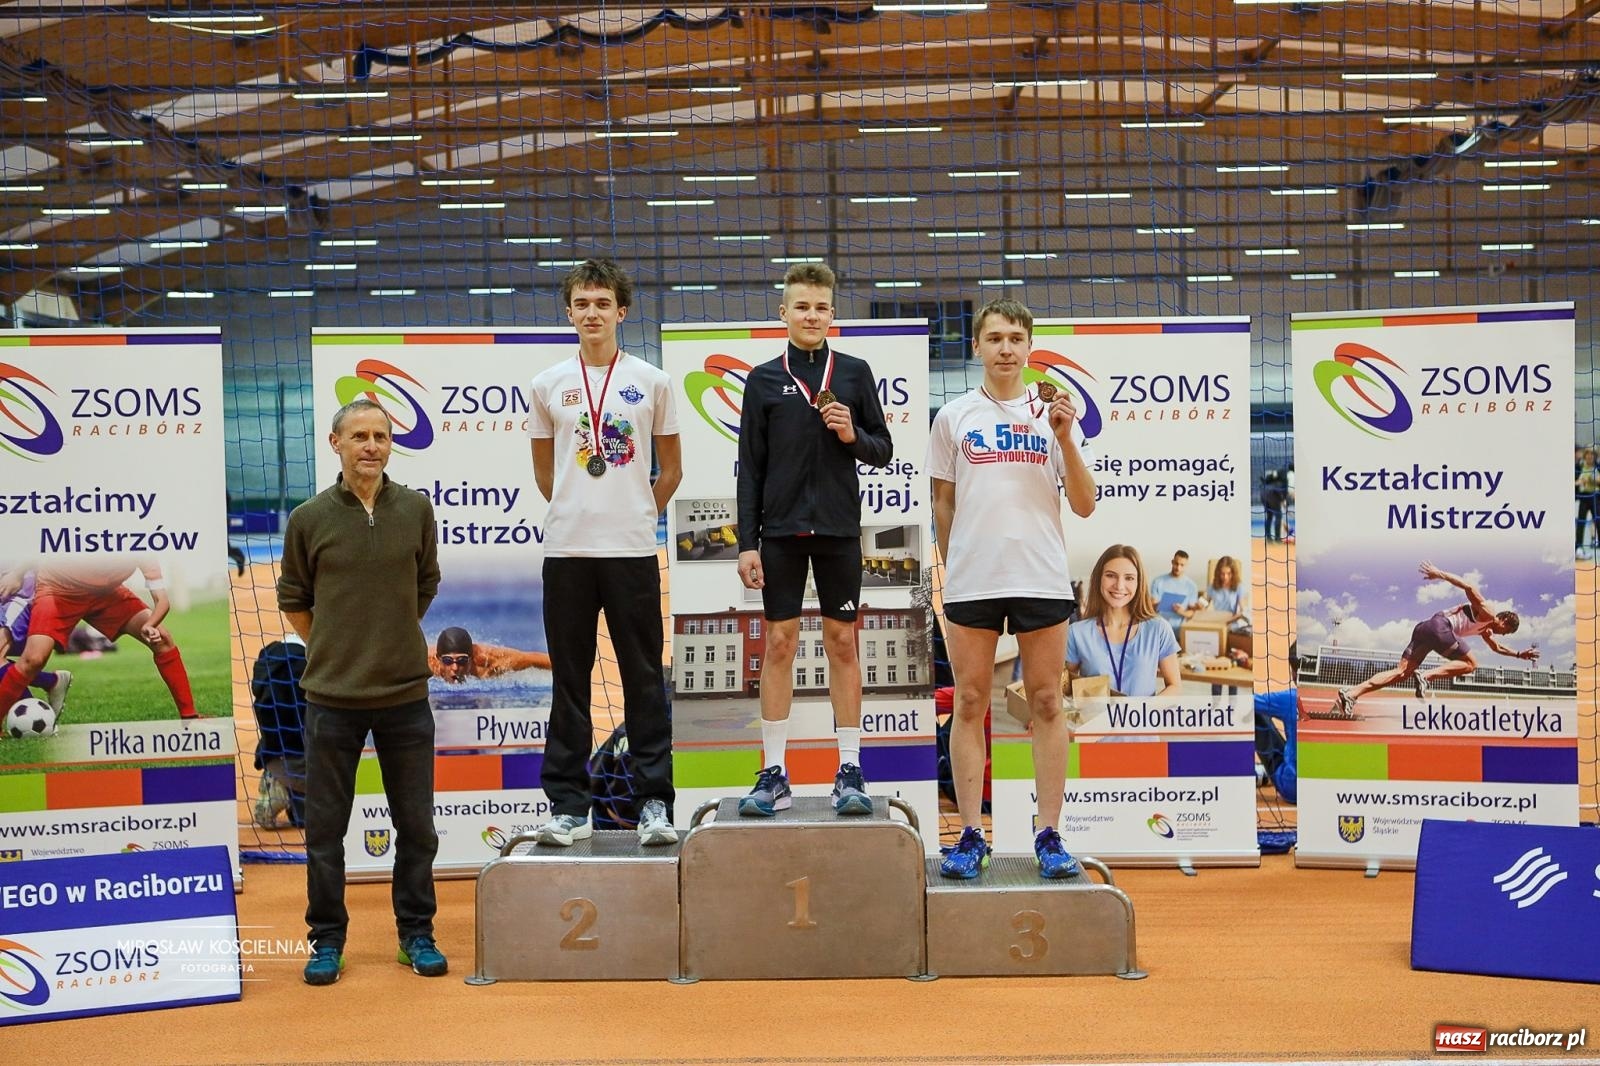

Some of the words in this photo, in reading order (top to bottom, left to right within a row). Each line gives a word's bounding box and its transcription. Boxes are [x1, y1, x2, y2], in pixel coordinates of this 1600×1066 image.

[1109, 374, 1231, 404] ZSOMS
[1421, 364, 1552, 396] ZSOMS
[71, 387, 202, 418] ZSOMS
[565, 393, 579, 402] ZS
[1421, 398, 1552, 414] RACIBÓRZ
[1110, 406, 1232, 421] RACIBÓRZ
[72, 420, 203, 436] RACIBÓRZ
[1012, 424, 1030, 433] UKS
[857, 462, 879, 476] cz
[885, 458, 919, 480] się.
[996, 451, 1049, 466] RYDUŁTOWY
[1093, 455, 1122, 476] się
[1128, 454, 1235, 476] pomagać,
[1155, 484, 1167, 497] z
[1172, 480, 1235, 502] pasją!
[1322, 464, 1504, 497] Kształcimy
[1387, 503, 1546, 530] Mistrzów
[40, 525, 199, 553] Mistrzów
[1106, 702, 1234, 728] Wolontariat
[1402, 704, 1562, 739] Lekkoatletyka
[90, 727, 145, 756] Piłka
[153, 726, 221, 753] nożna
[1336, 791, 1537, 812] www.smsraciborz.pl
[1064, 815, 1115, 823] Województwo
[1176, 812, 1211, 822] ZSOMS
[1372, 816, 1422, 826] Województw
[0, 882, 58, 909] EGO
[65, 884, 86, 904] w
[94, 873, 224, 901] Raciborzu
[786, 876, 817, 930] 1
[559, 897, 599, 951] 2
[1009, 909, 1049, 964] 3
[56, 943, 160, 975] ZSOMS
[56, 969, 161, 990] RACIBÓRZ
